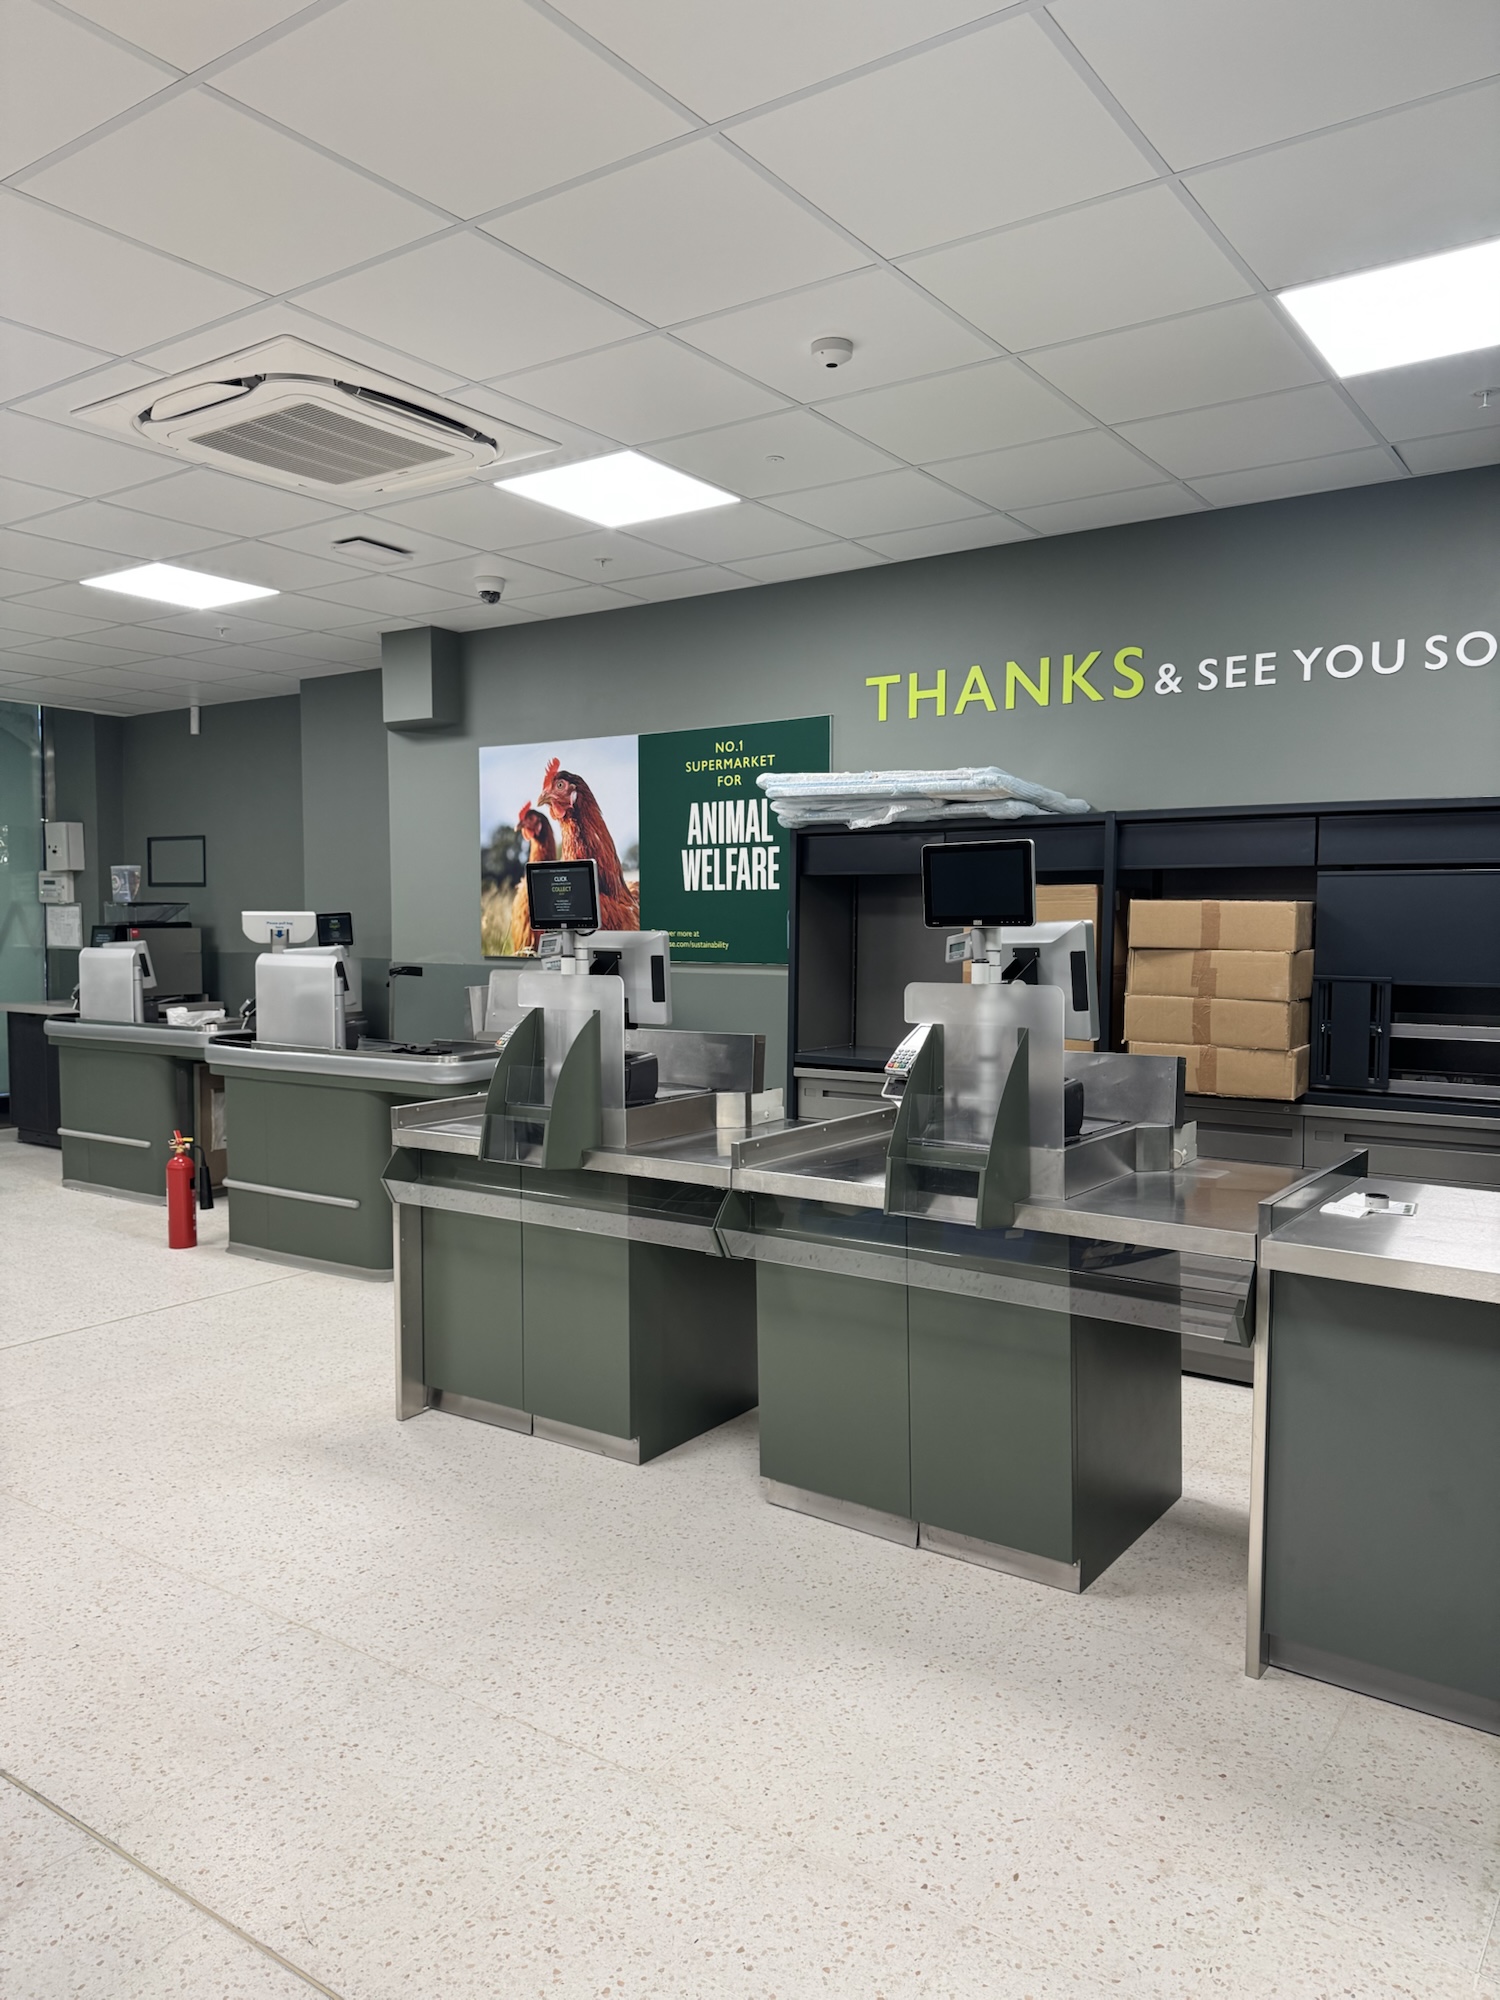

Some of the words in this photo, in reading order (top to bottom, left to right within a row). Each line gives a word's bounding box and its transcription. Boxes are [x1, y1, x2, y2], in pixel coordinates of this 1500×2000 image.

[866, 646, 1145, 722] THANKS
[1154, 662, 1183, 695] &
[1197, 651, 1277, 691] SEE
[1292, 638, 1406, 682] YOU
[1424, 630, 1498, 671] SO
[715, 740, 744, 753] NO.1
[685, 754, 776, 773] SUPERMARKET
[717, 774, 742, 787] FOR
[687, 798, 774, 845] ANIMAL
[681, 846, 780, 891] WELFARE
[693, 930, 700, 938] at
[668, 940, 729, 951] se.com/sustainability
